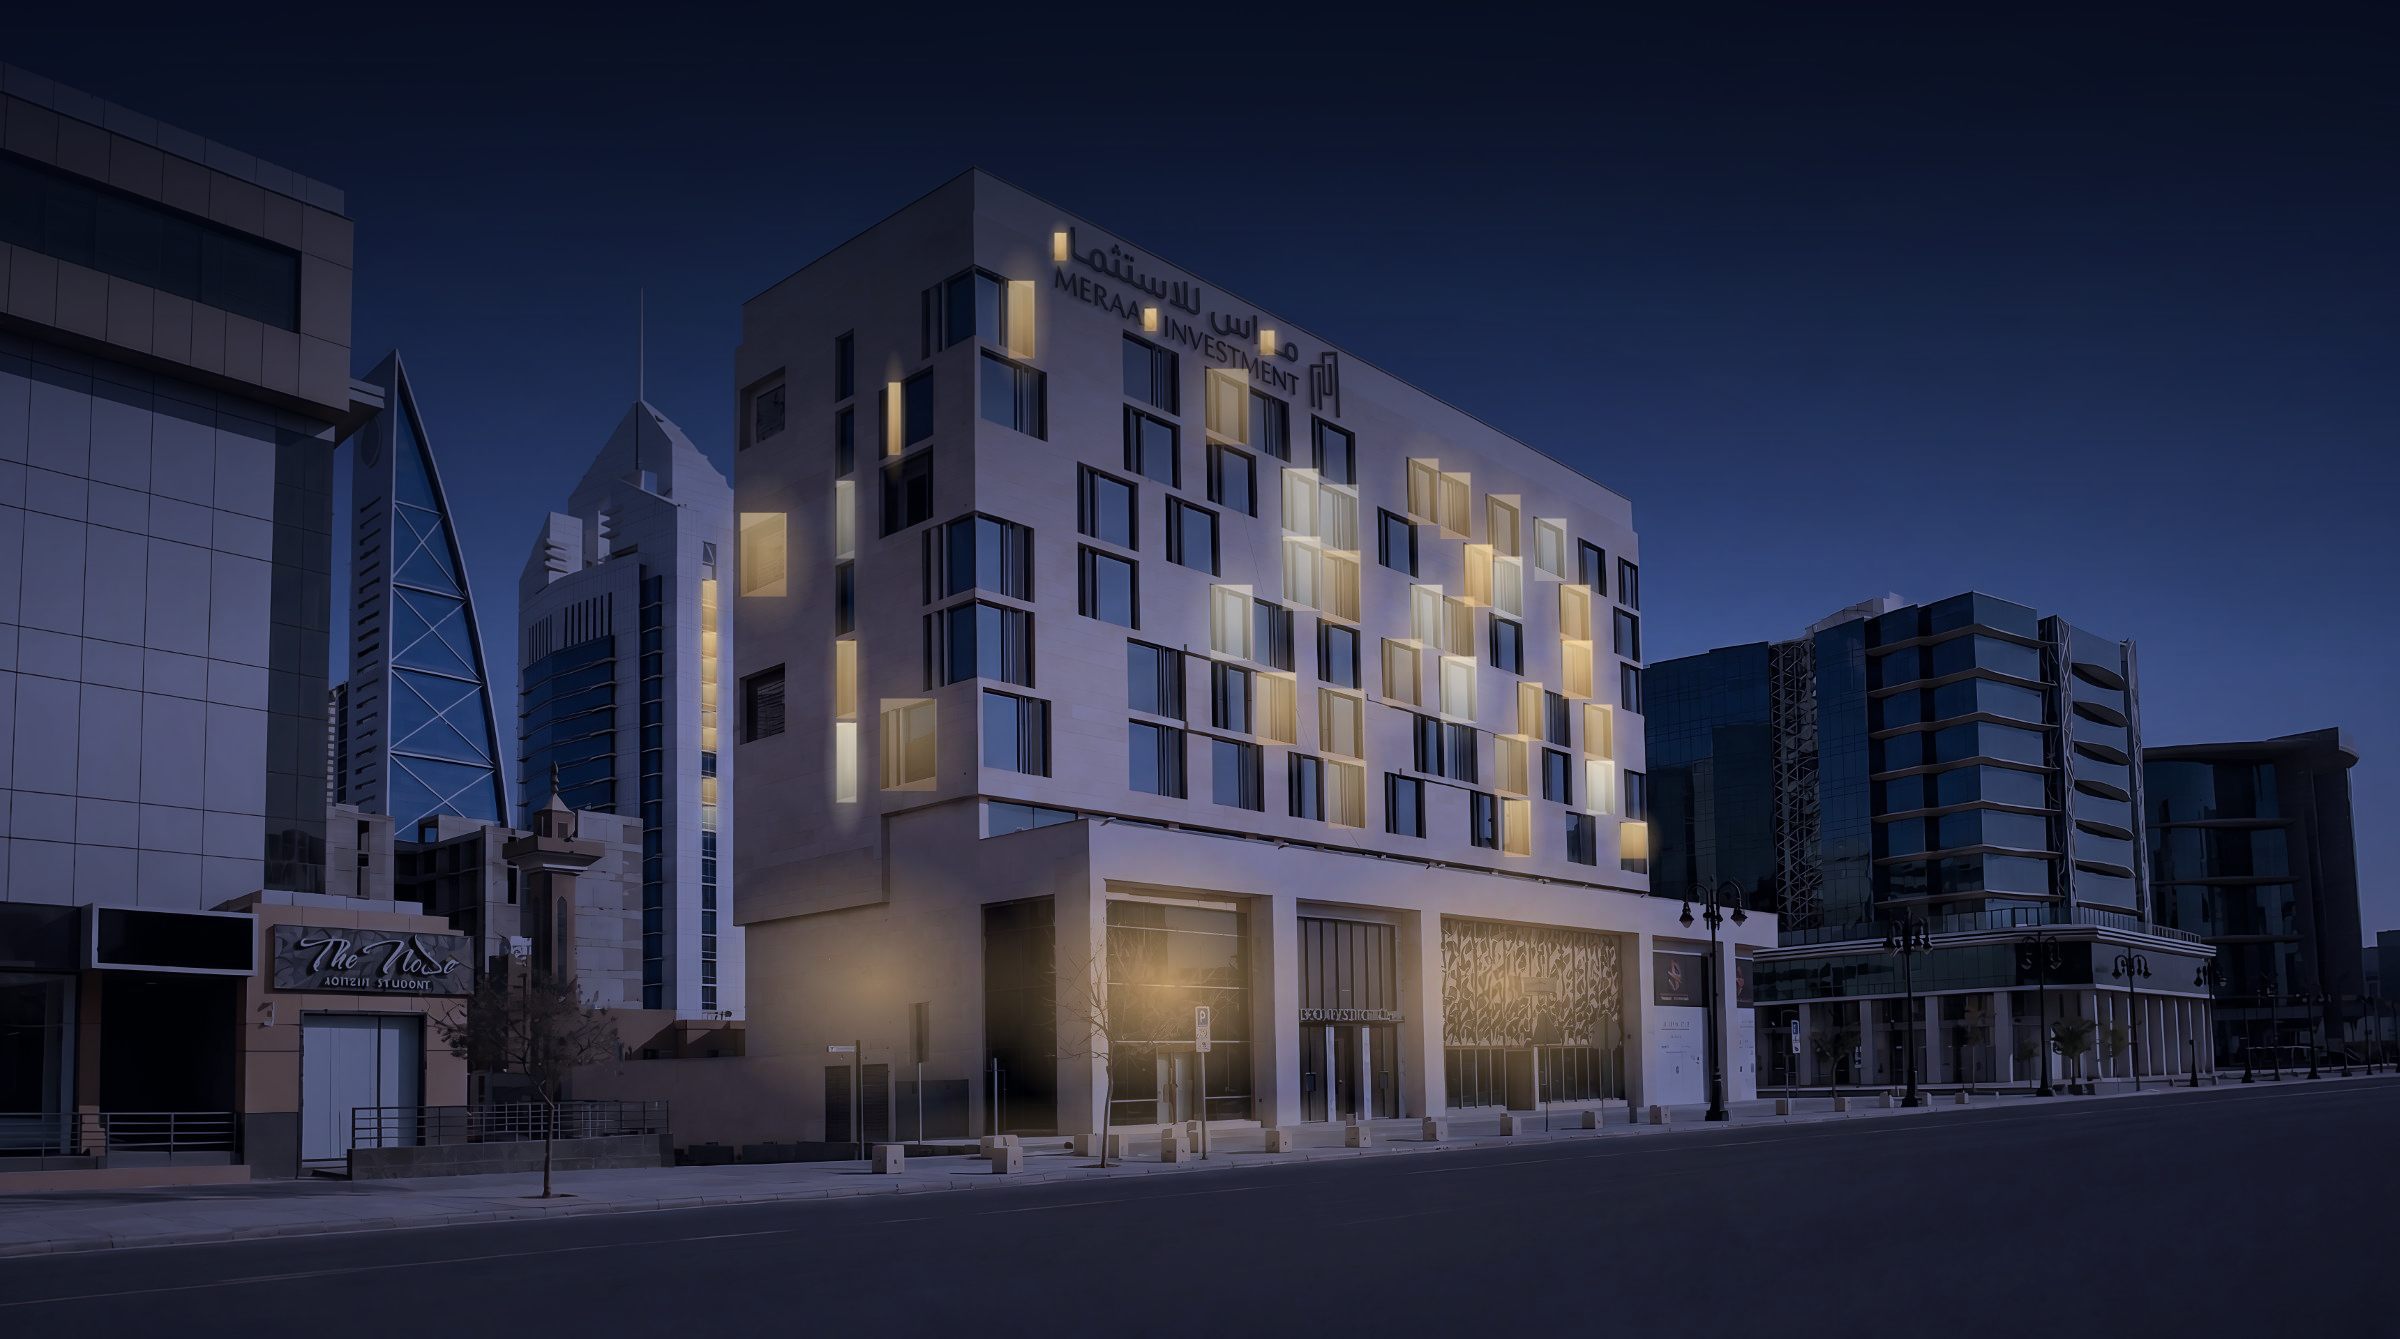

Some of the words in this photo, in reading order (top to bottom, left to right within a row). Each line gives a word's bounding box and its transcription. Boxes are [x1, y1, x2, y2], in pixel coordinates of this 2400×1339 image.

[1070, 226, 1202, 316] للاستثما
[1054, 265, 1144, 326] MERAA
[1164, 315, 1300, 396] INVESTMENT
[1210, 311, 1299, 362] ماس
[300, 937, 358, 972] The
